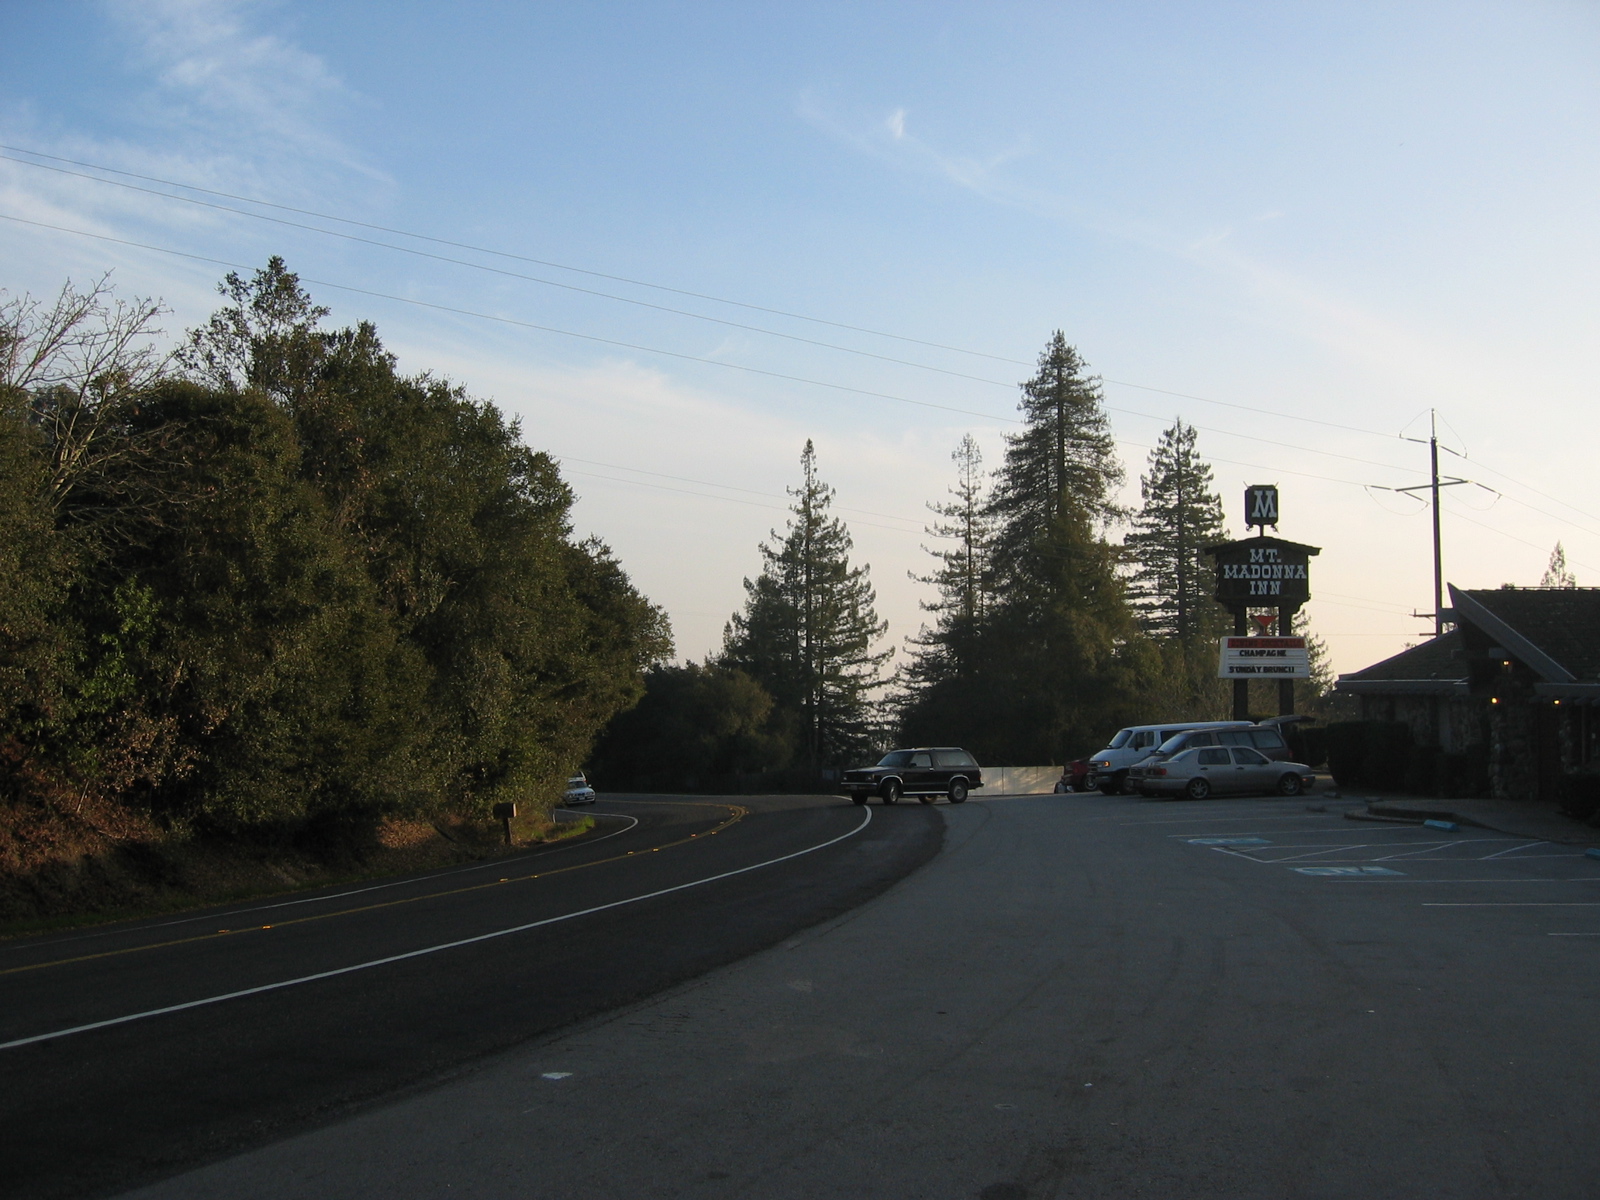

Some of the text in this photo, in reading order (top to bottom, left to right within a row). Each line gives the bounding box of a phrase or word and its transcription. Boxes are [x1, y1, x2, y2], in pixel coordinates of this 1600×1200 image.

[1251, 490, 1277, 518] M
[1249, 549, 1282, 563] MT.
[1223, 564, 1307, 579] MADONNA
[1249, 581, 1281, 595] INN
